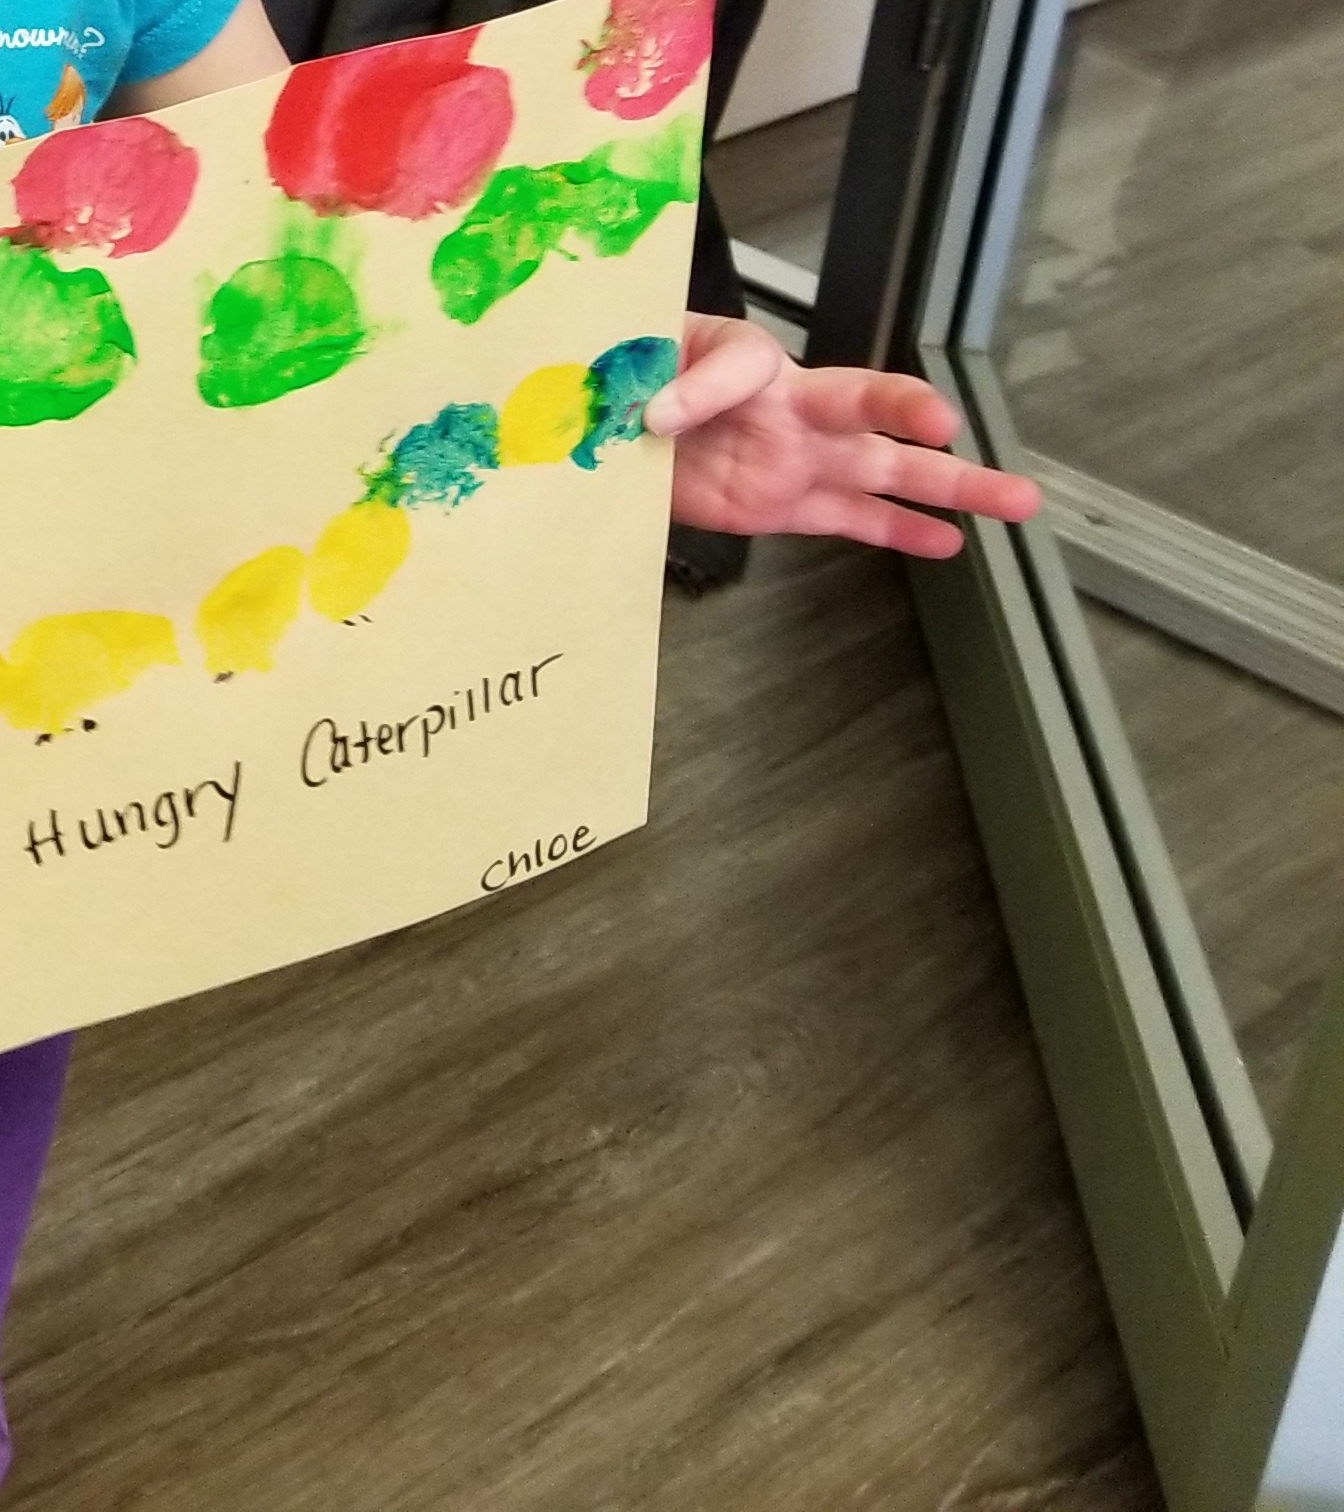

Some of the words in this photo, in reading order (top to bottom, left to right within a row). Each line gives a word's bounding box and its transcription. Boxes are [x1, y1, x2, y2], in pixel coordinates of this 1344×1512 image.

[24, 760, 242, 866] Hungry
[301, 652, 564, 788] Caterpillar
[481, 824, 597, 891] Chloe
